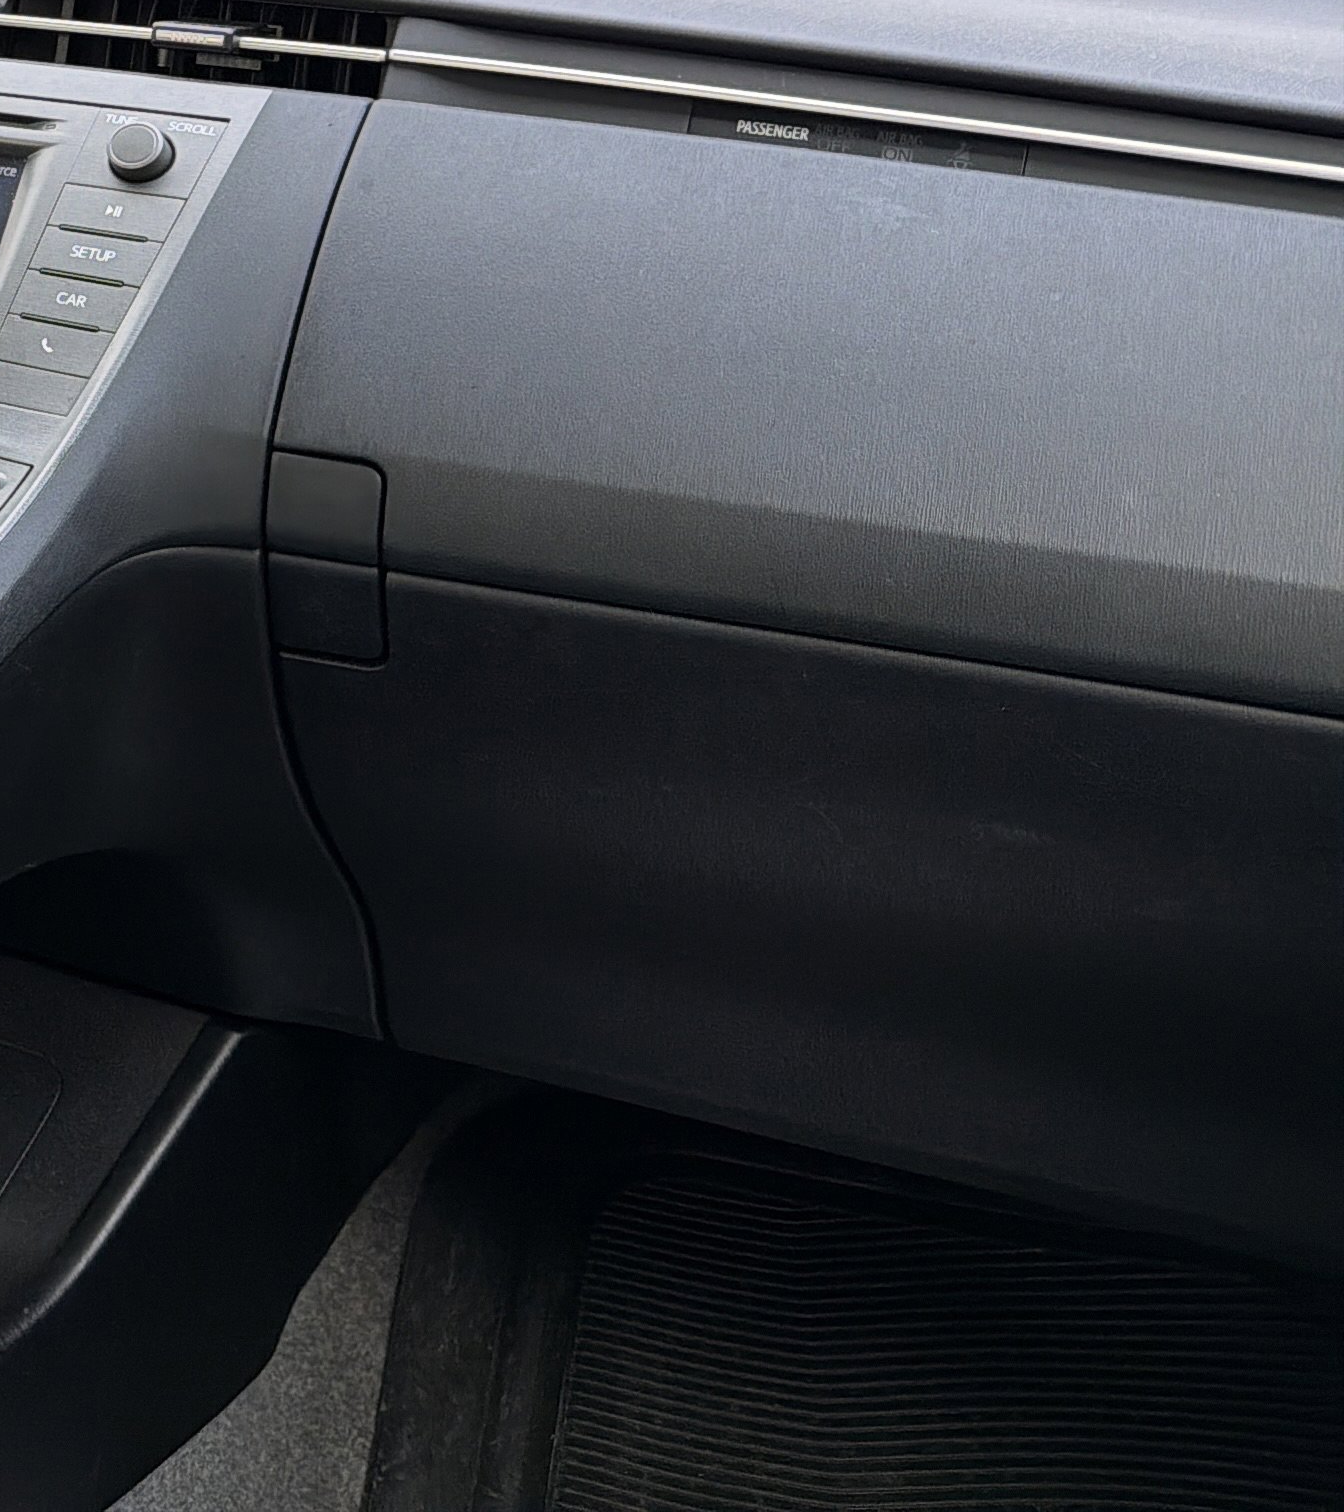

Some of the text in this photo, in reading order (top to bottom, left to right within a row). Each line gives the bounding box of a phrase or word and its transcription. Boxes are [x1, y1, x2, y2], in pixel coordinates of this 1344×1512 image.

[167, 120, 217, 136] SCROLL
[736, 119, 810, 141] PASSENGER
[883, 147, 912, 161] ON
[69, 245, 117, 262] SETUP
[56, 291, 87, 308] CAR
